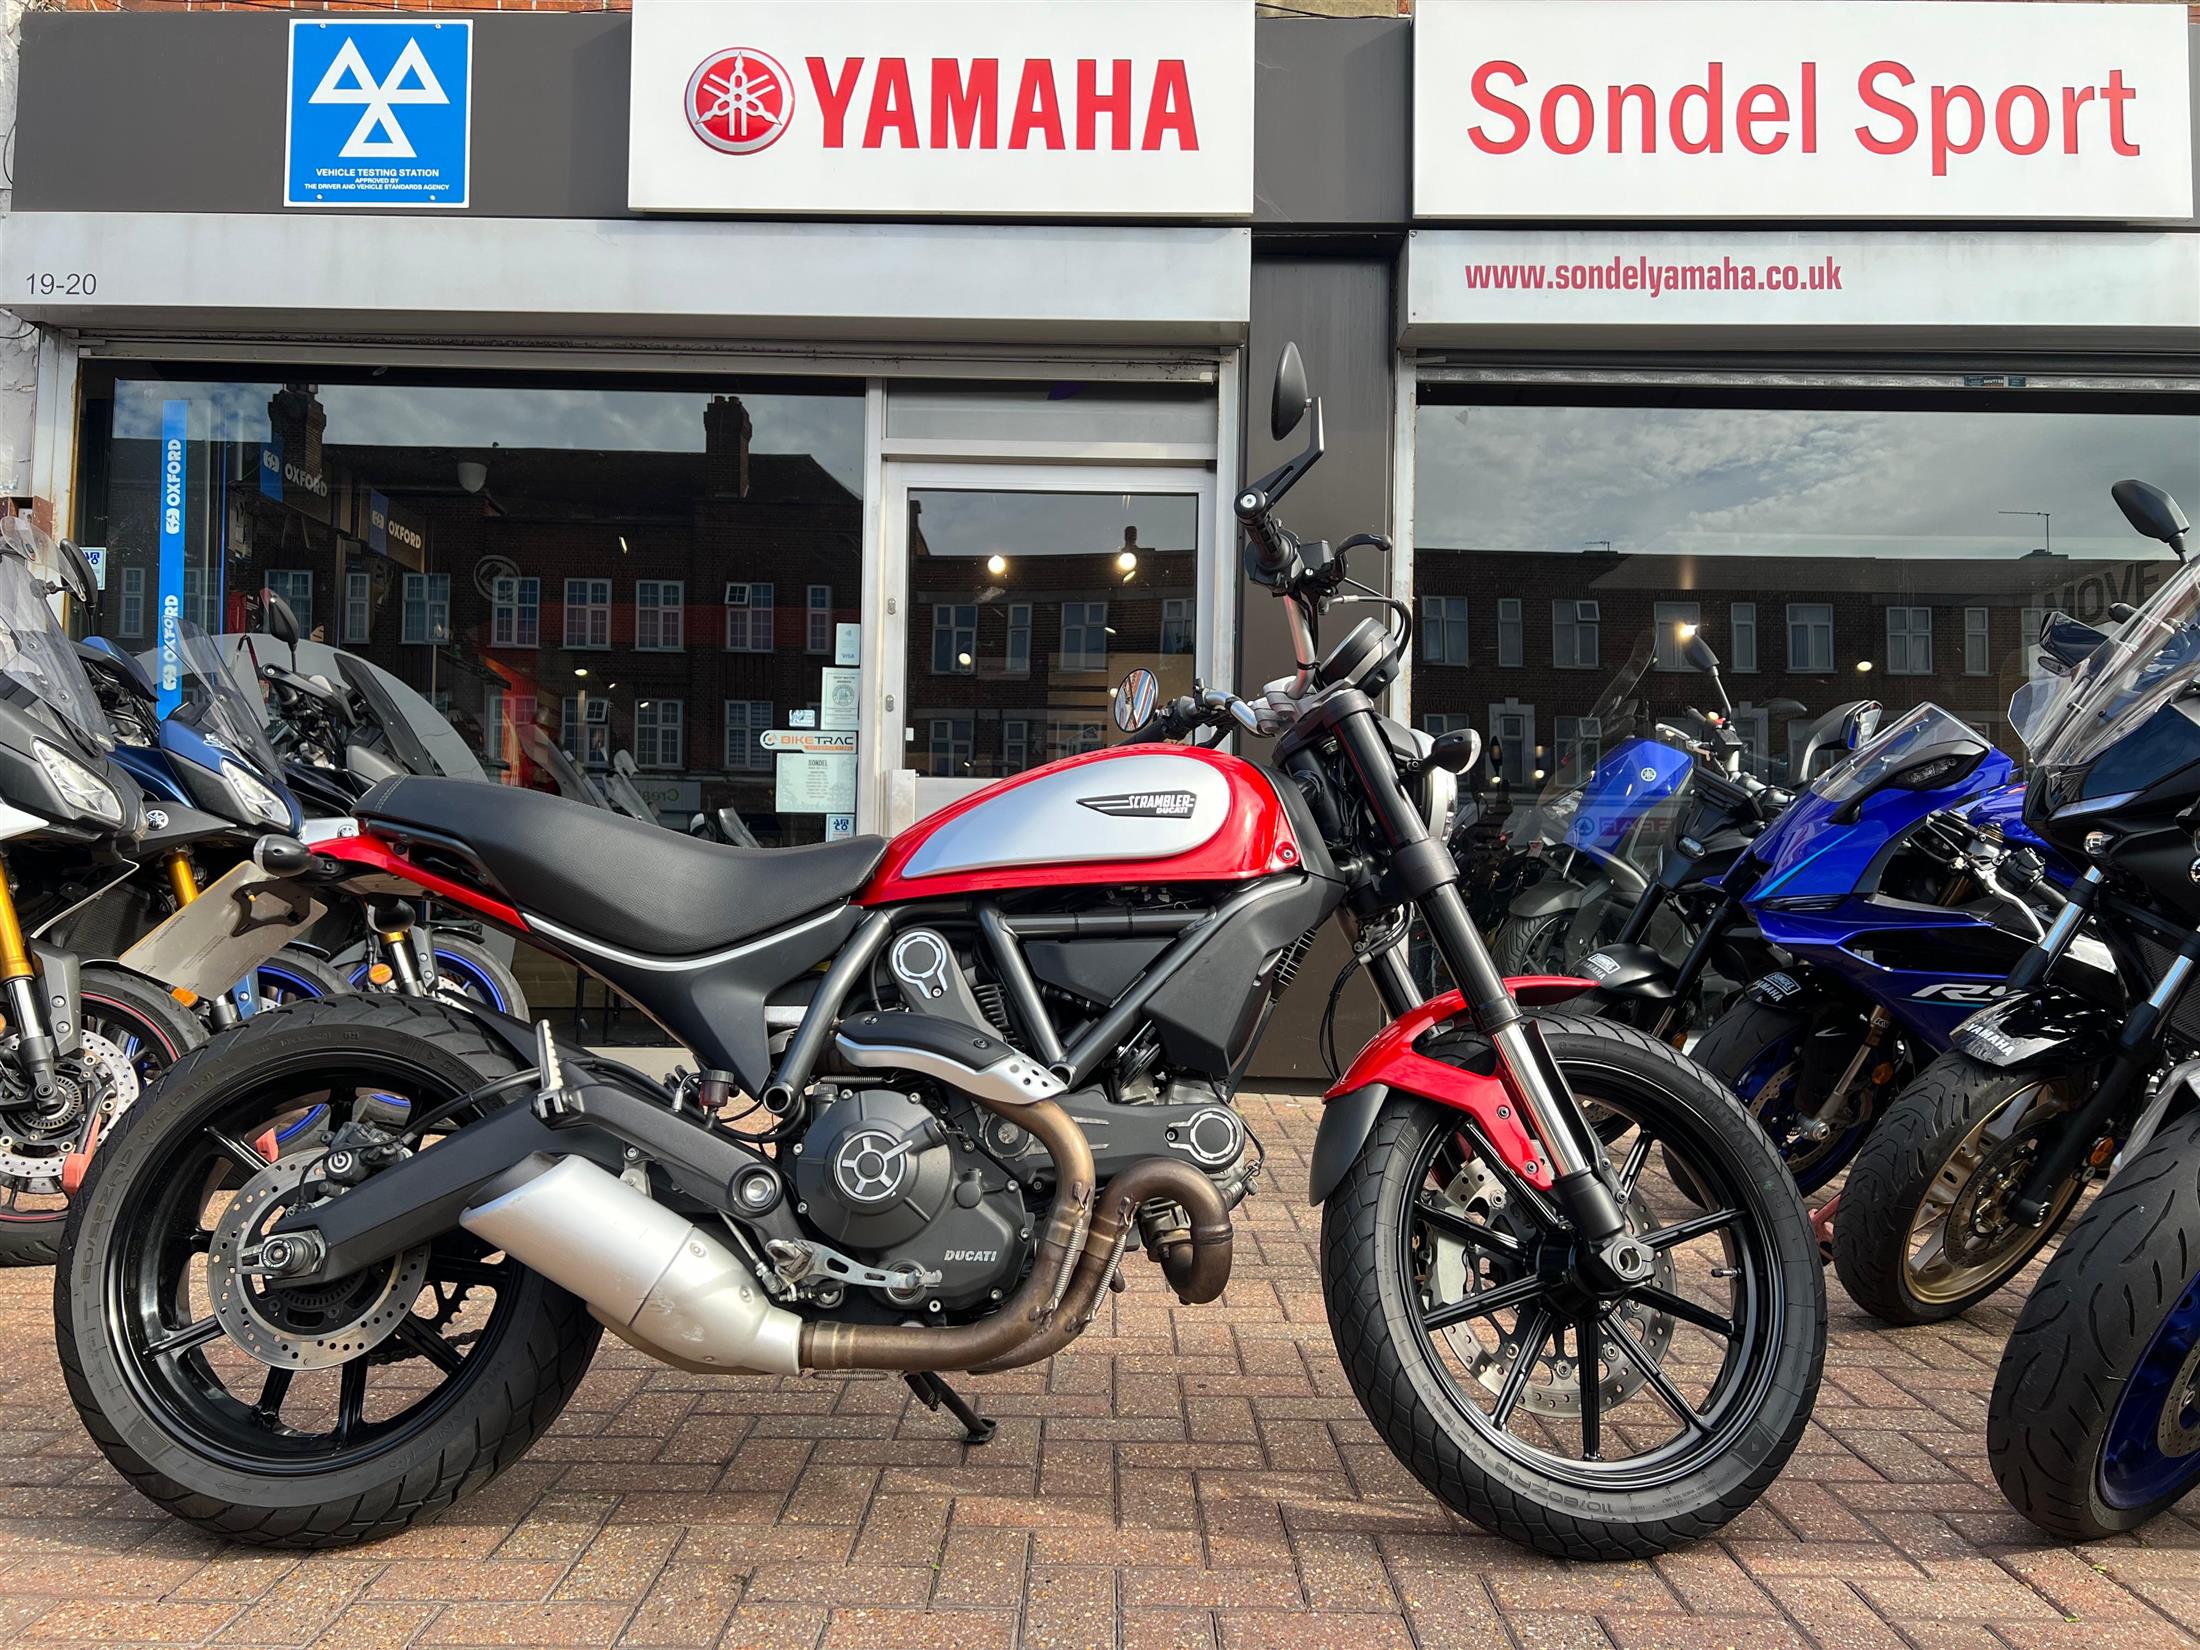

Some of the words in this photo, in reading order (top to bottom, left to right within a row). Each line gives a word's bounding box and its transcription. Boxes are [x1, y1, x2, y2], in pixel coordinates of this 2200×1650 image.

[804, 56, 1200, 151] YAMAHA
[1466, 60, 1817, 156] Sondel
[1853, 60, 2141, 177] Sport
[316, 168, 355, 176] VEHICLE
[357, 169, 397, 177] TESTING
[398, 169, 439, 177] STATION
[26, 273, 97, 295] 19-20
[1465, 255, 1843, 298] www.sondelyamaha.co.uk
[166, 439, 182, 507] OXFORD
[285, 463, 328, 498] OXFORD
[387, 519, 422, 549] OXFORD
[163, 594, 179, 663] OXFORD
[781, 736, 854, 745] BIKETRAC
[1128, 794, 1192, 809] SCRAMBLER
[1966, 1023, 2016, 1057] YAMAHA
[1696, 1091, 1769, 1170] MUTANT
[944, 1250, 997, 1262] DUCATI
